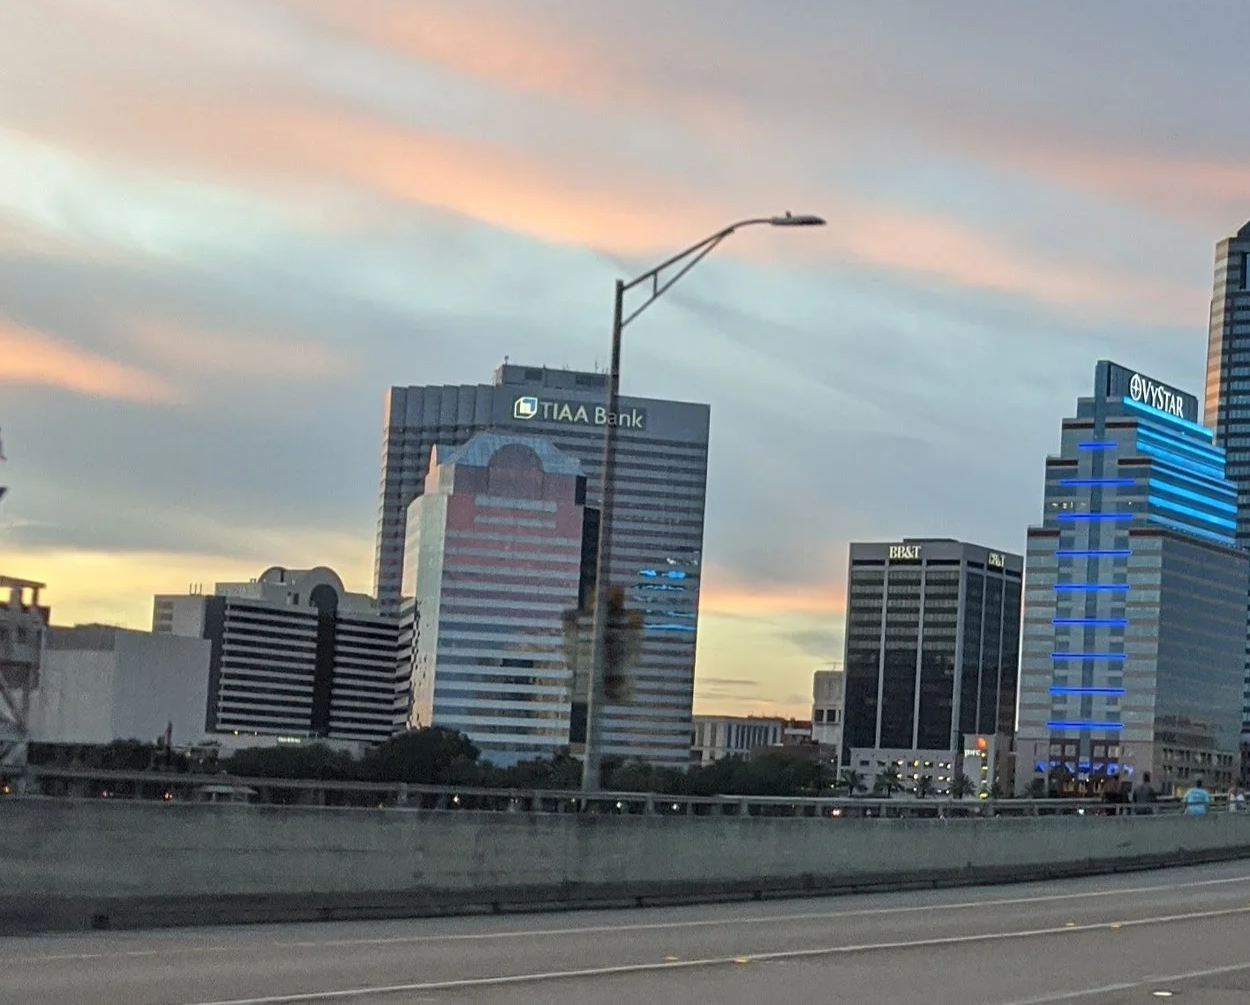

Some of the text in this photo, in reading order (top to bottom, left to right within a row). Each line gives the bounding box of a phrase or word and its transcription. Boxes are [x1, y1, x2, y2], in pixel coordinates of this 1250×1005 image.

[1141, 378, 1184, 419] VYSTAR
[540, 401, 644, 428] TIAA Bank
[889, 545, 922, 559] BB&T
